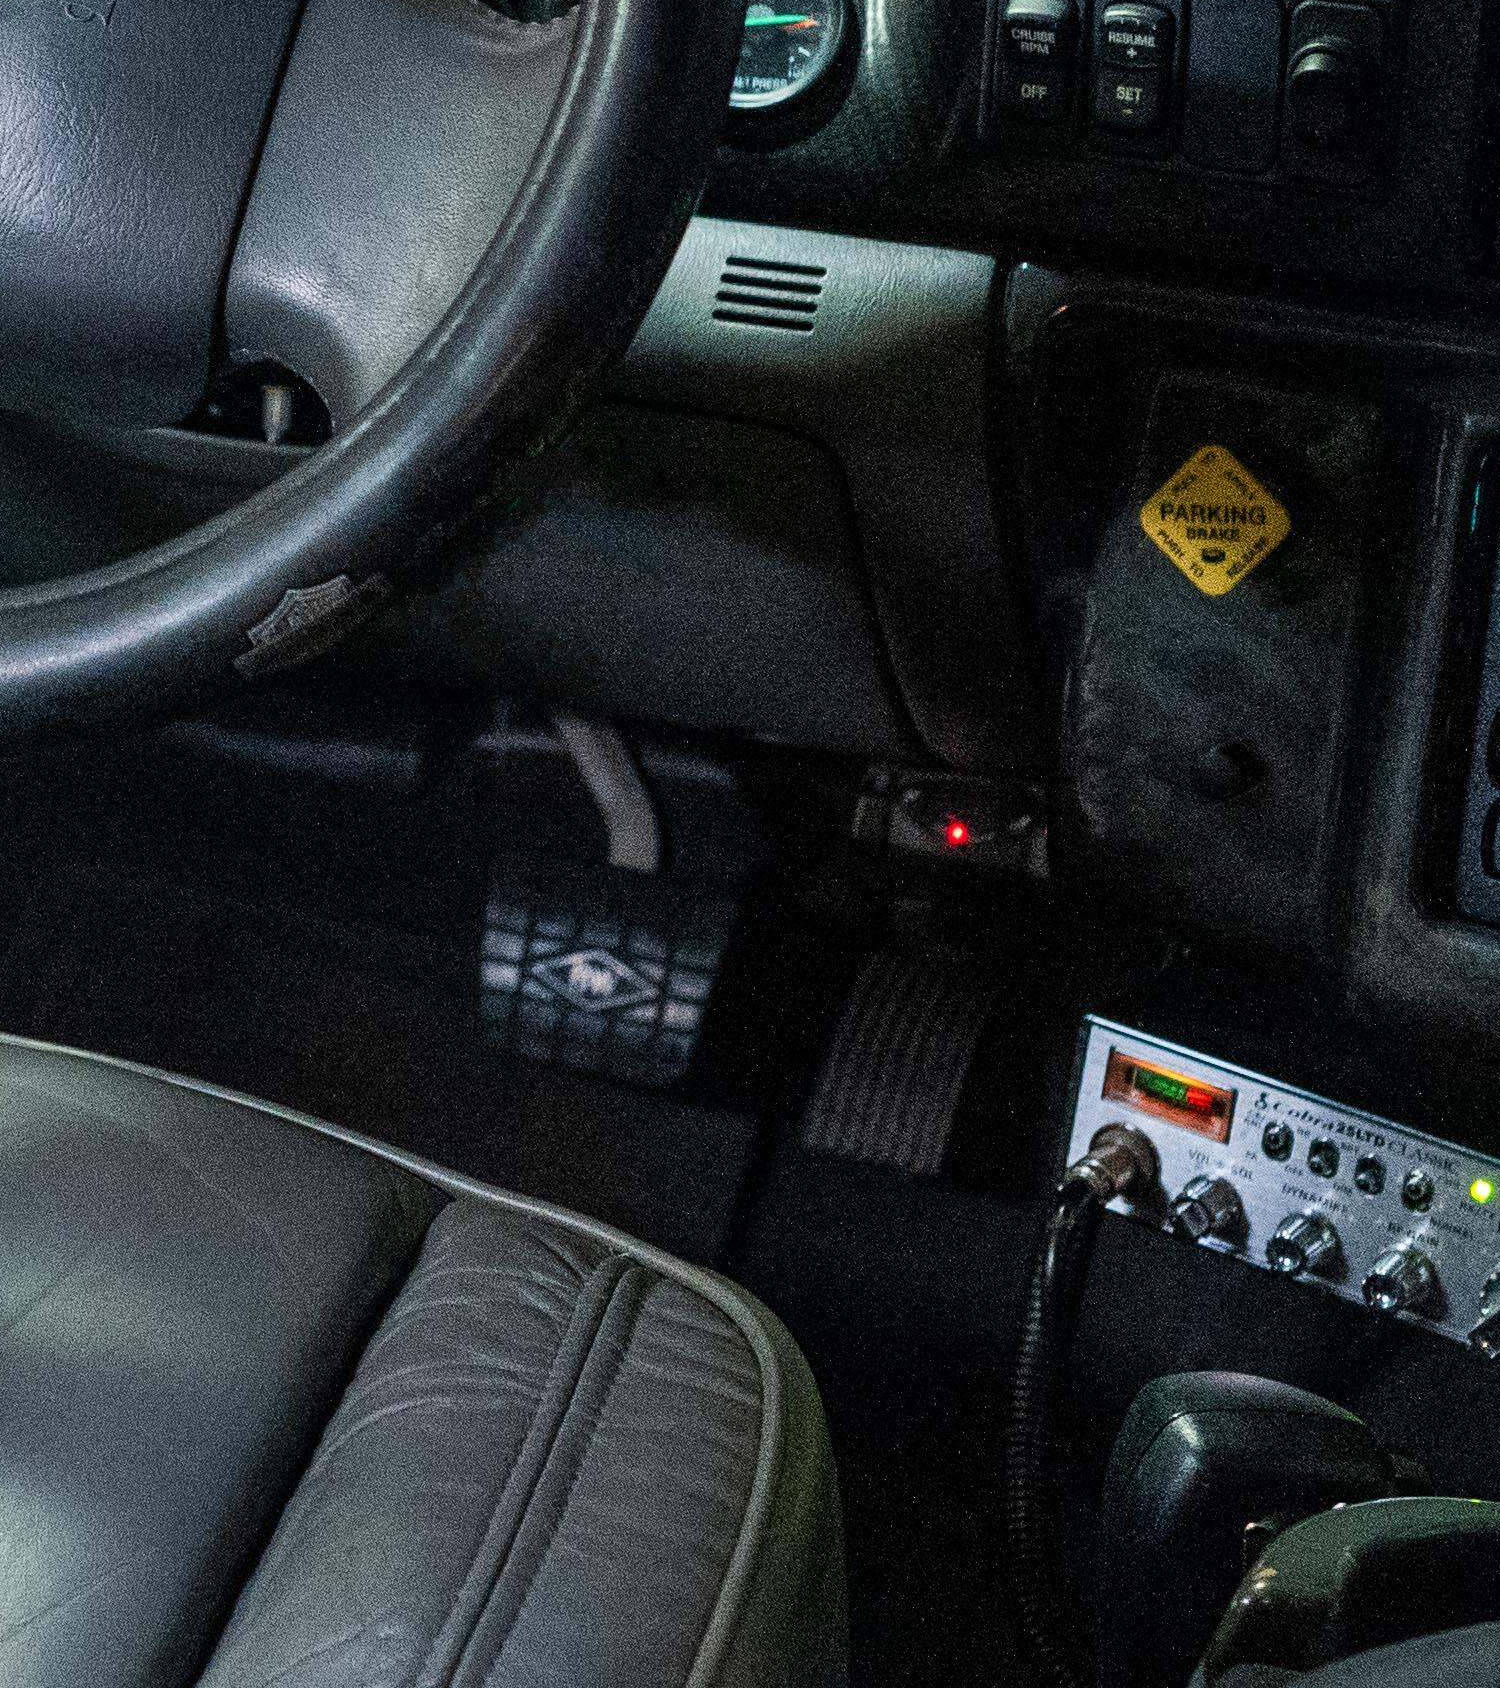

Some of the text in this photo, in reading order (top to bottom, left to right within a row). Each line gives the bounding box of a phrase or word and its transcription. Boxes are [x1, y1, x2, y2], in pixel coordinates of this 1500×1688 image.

[1020, 42, 1050, 55] RPM
[1021, 85, 1048, 100] OFF
[1116, 87, 1142, 103] SET
[1159, 504, 1267, 525] PARKING
[1186, 527, 1240, 541] BRAKE
[1272, 1100, 1335, 1133] Cobra
[1388, 1138, 1462, 1172] CLASSIC
